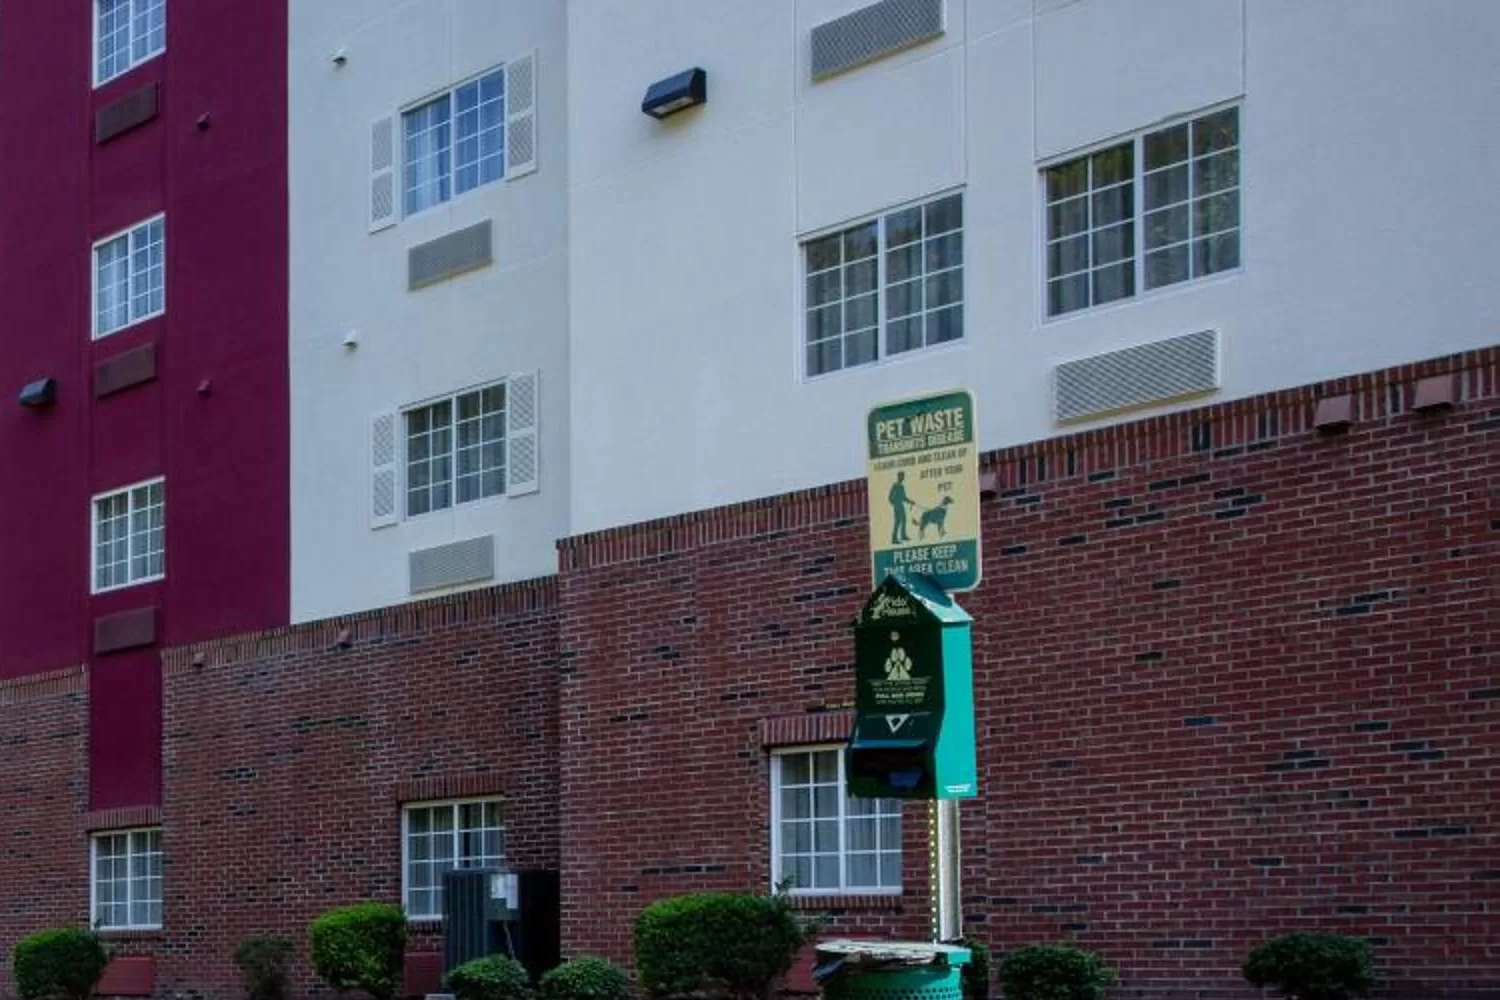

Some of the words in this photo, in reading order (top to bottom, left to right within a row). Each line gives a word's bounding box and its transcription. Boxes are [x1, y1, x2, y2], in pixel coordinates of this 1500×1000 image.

[876, 418, 904, 441] PET
[910, 407, 965, 434] WASTE
[893, 547, 930, 565] PLEASE
[931, 544, 957, 559] KEEP
[935, 559, 969, 576] CLEAN
